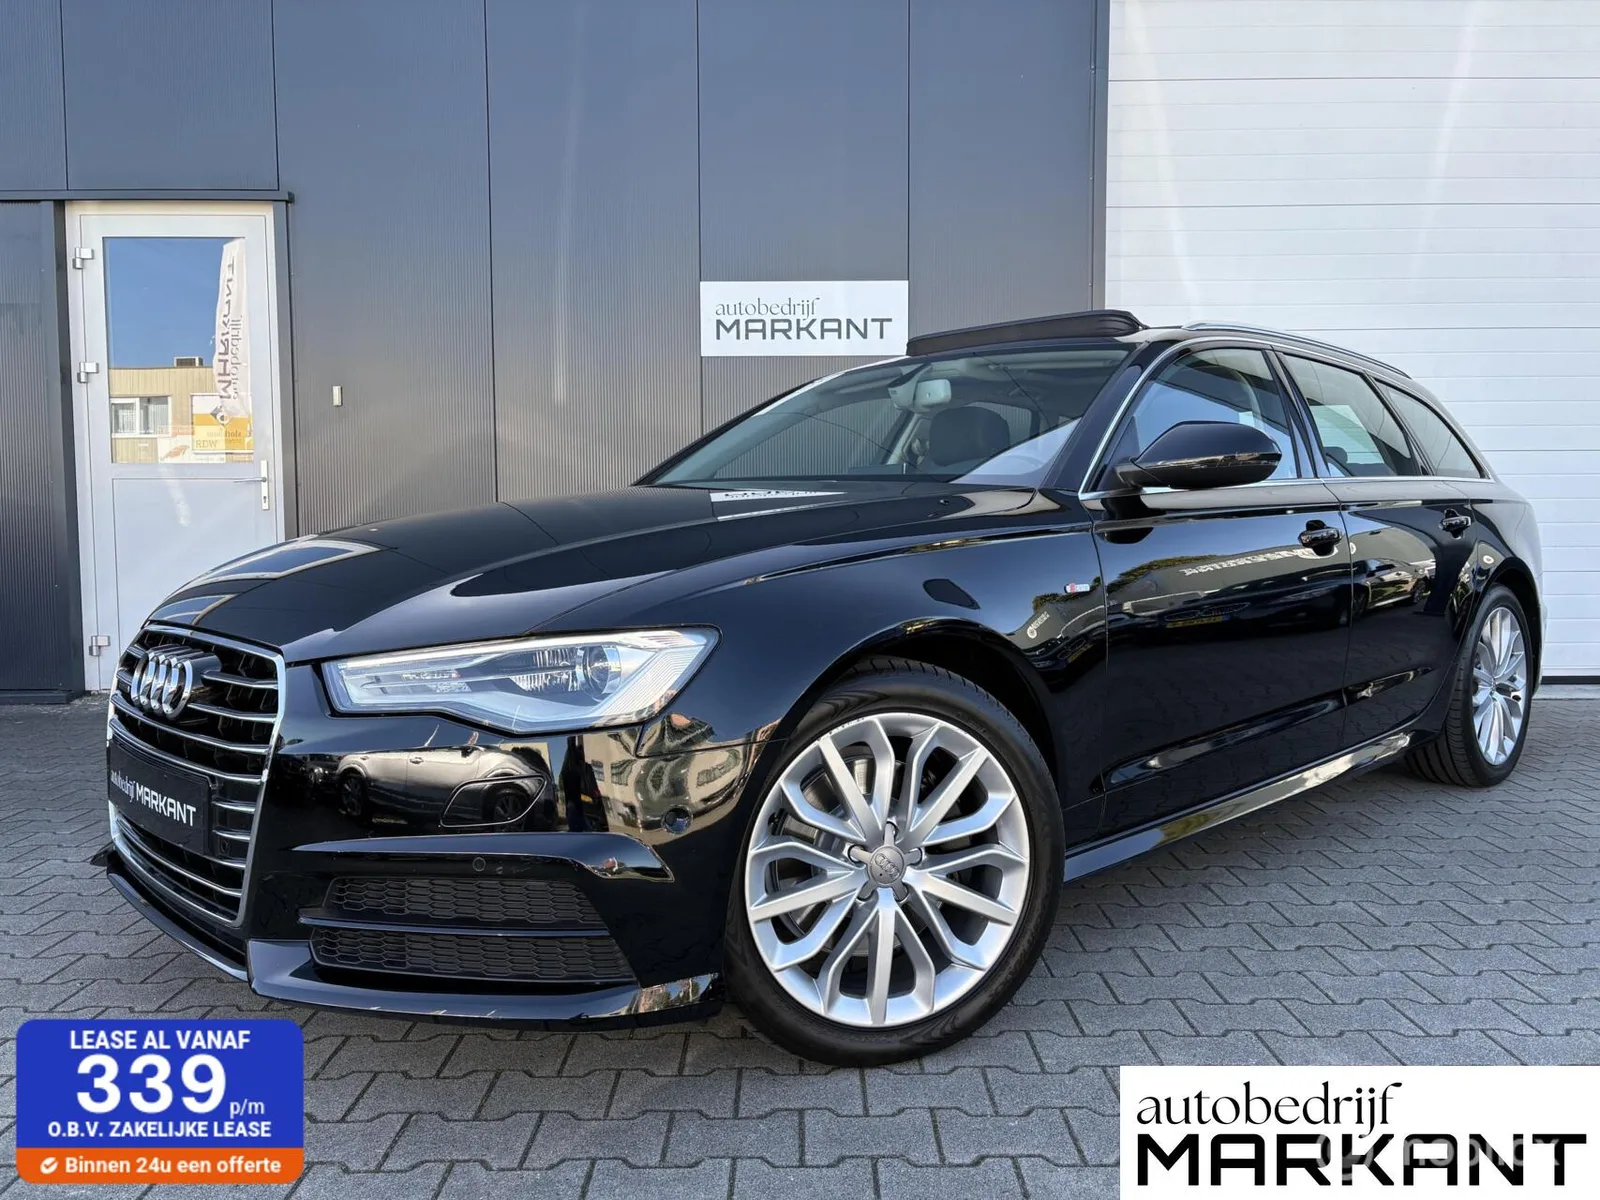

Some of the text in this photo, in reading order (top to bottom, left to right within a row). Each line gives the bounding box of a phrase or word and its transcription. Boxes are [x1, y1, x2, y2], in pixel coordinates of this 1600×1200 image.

[715, 297, 821, 319] autobedrijf
[716, 318, 893, 340] MARKANT
[136, 782, 197, 827] MARKANT
